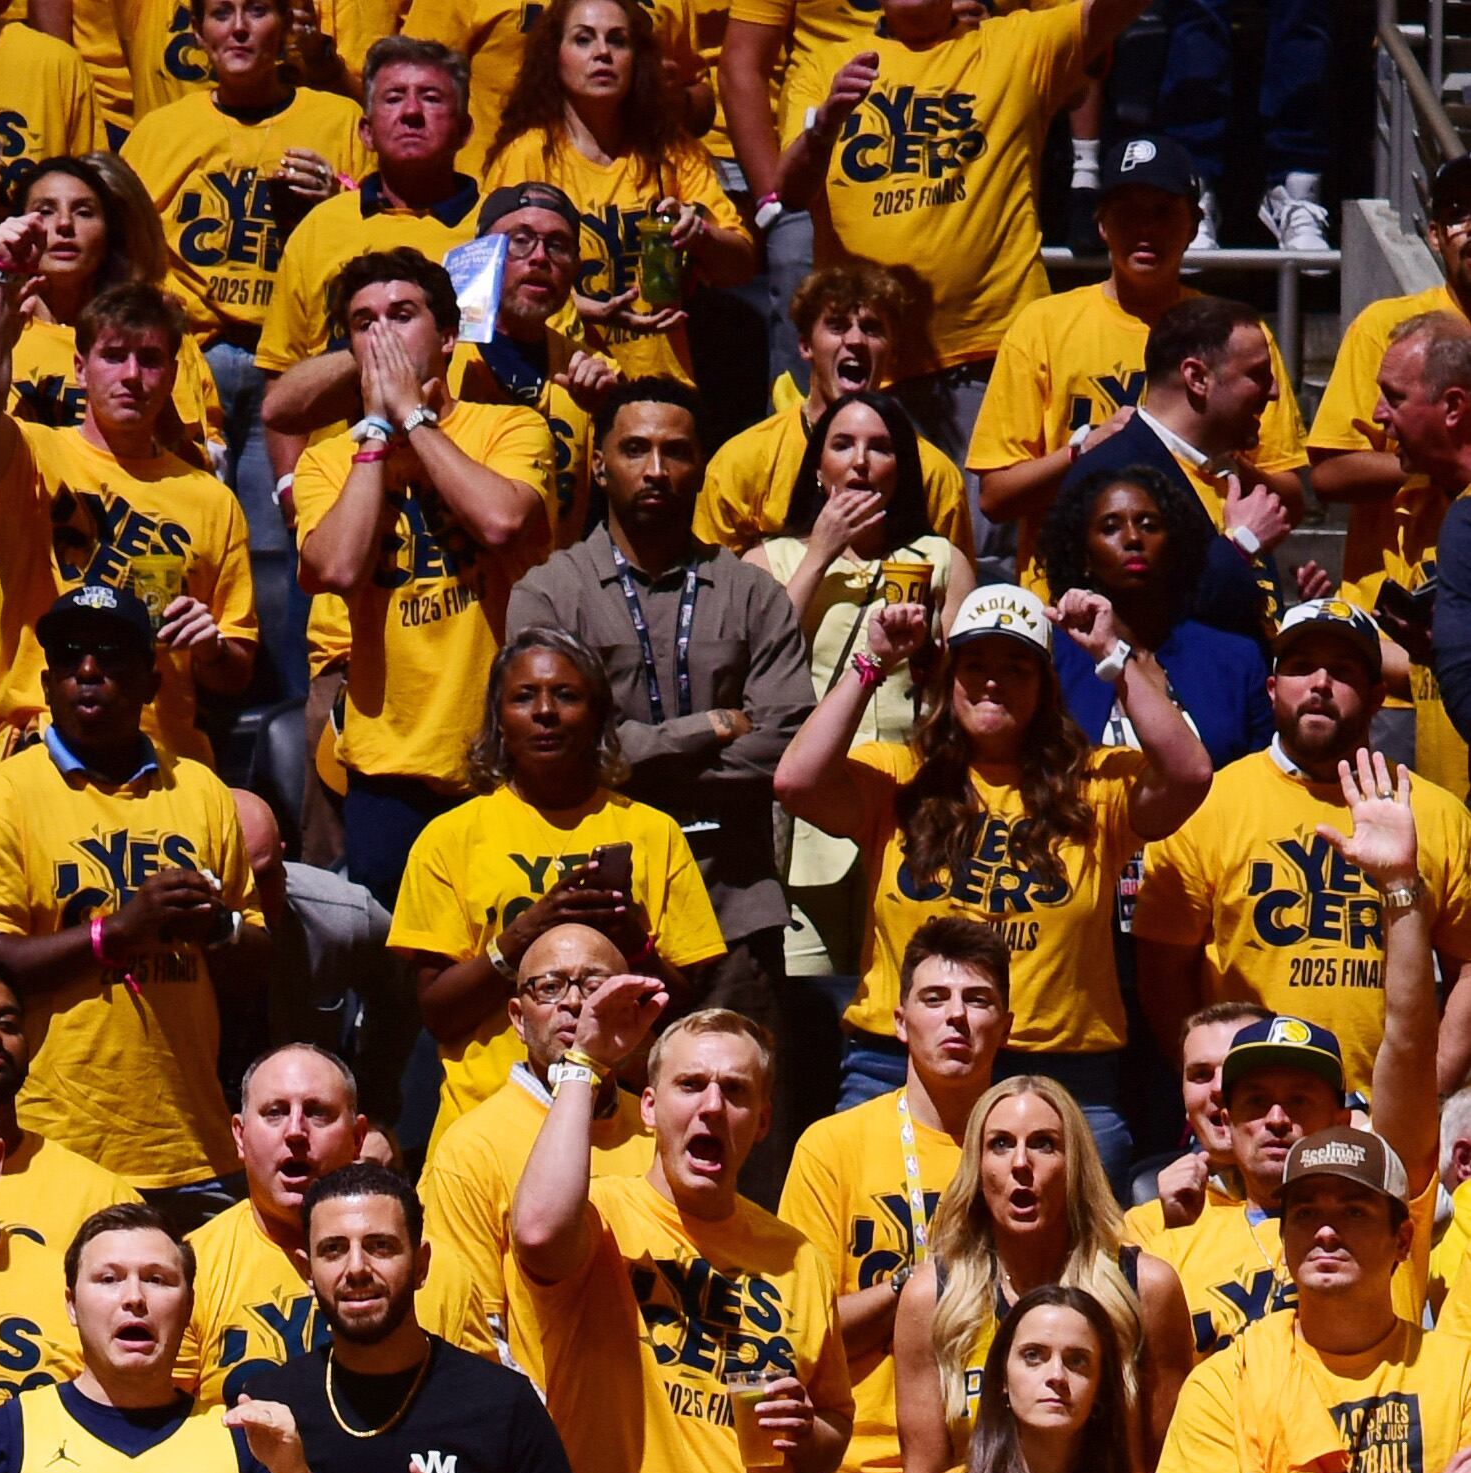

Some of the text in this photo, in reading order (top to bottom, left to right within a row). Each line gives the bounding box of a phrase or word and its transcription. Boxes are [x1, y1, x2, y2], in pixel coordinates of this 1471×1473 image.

[868, 85, 977, 136] YES
[873, 188, 916, 217] 2025
[398, 593, 442, 628] 2025
[967, 596, 1038, 632] INDIANA
[1289, 957, 1338, 988] 2025
[1383, 1423, 1409, 1441] JUST
